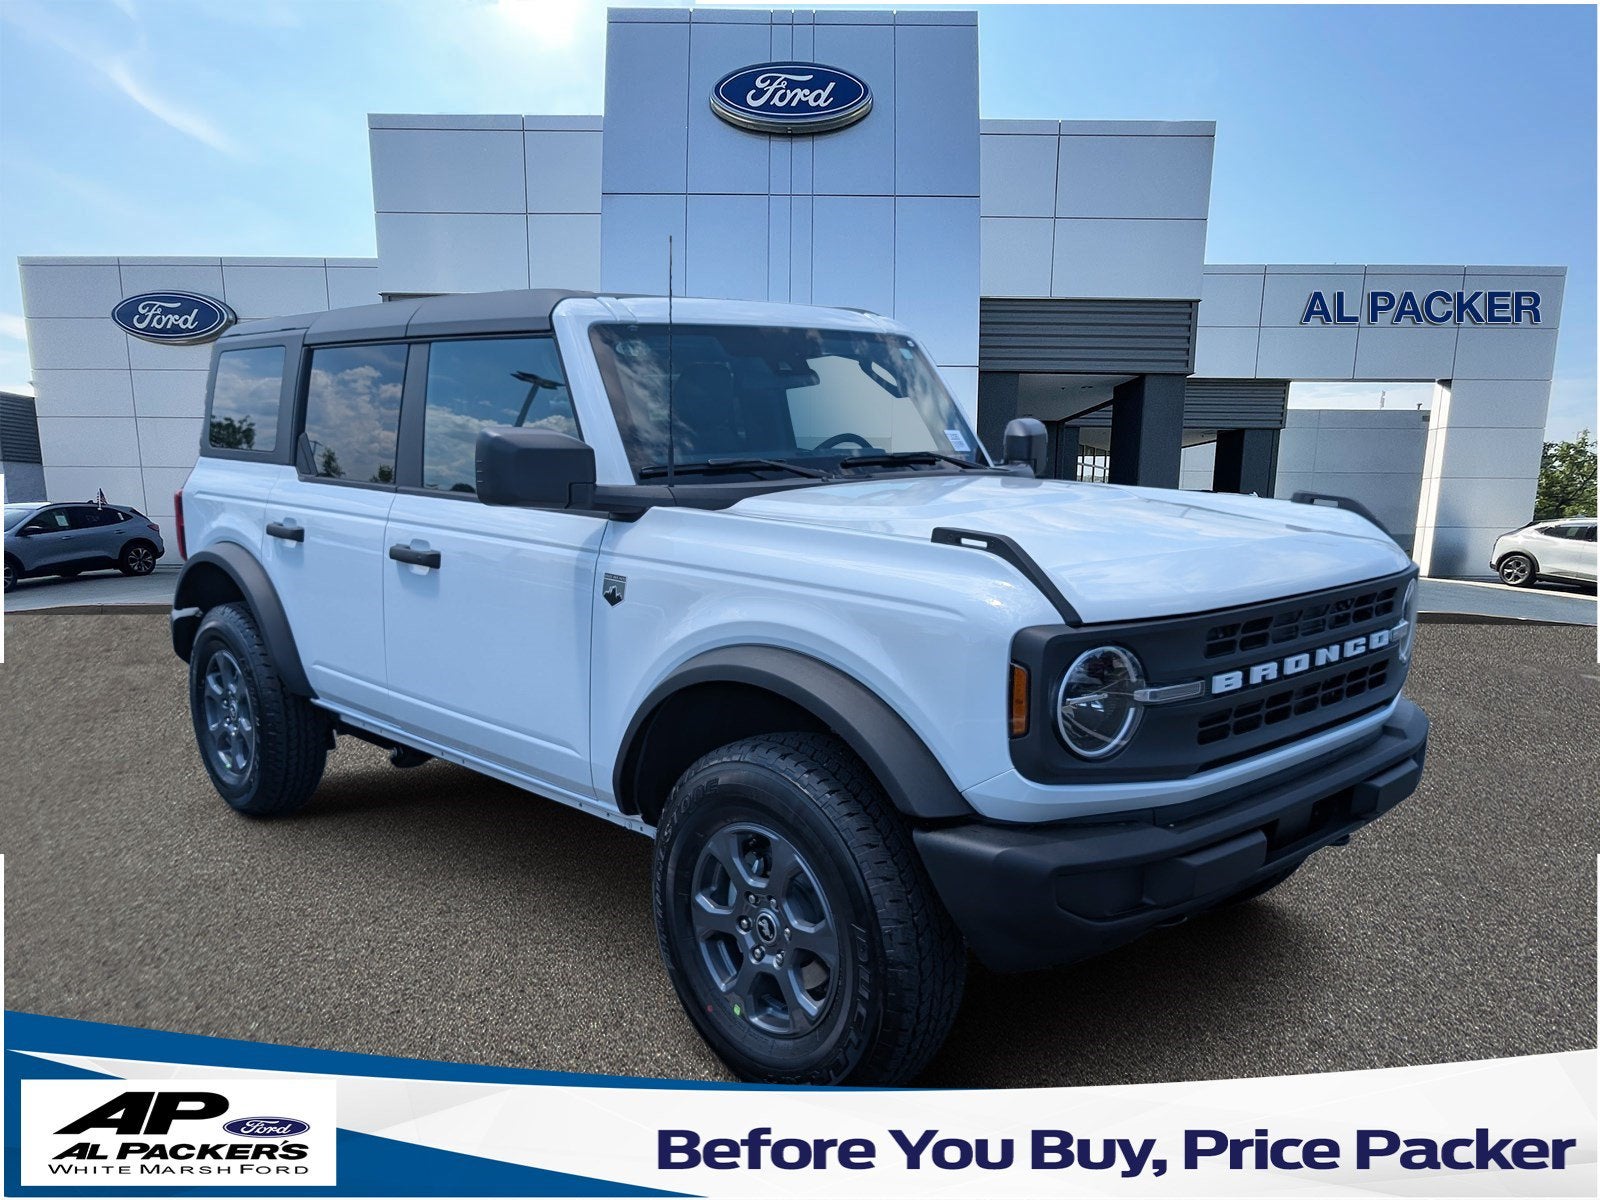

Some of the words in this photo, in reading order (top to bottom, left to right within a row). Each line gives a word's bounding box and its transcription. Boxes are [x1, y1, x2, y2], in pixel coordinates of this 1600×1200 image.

[746, 73, 836, 107] Ford
[133, 301, 199, 329] Ford
[1301, 290, 1360, 324] AL
[1368, 289, 1542, 325] PACKER
[1211, 629, 1390, 694] BRONCO
